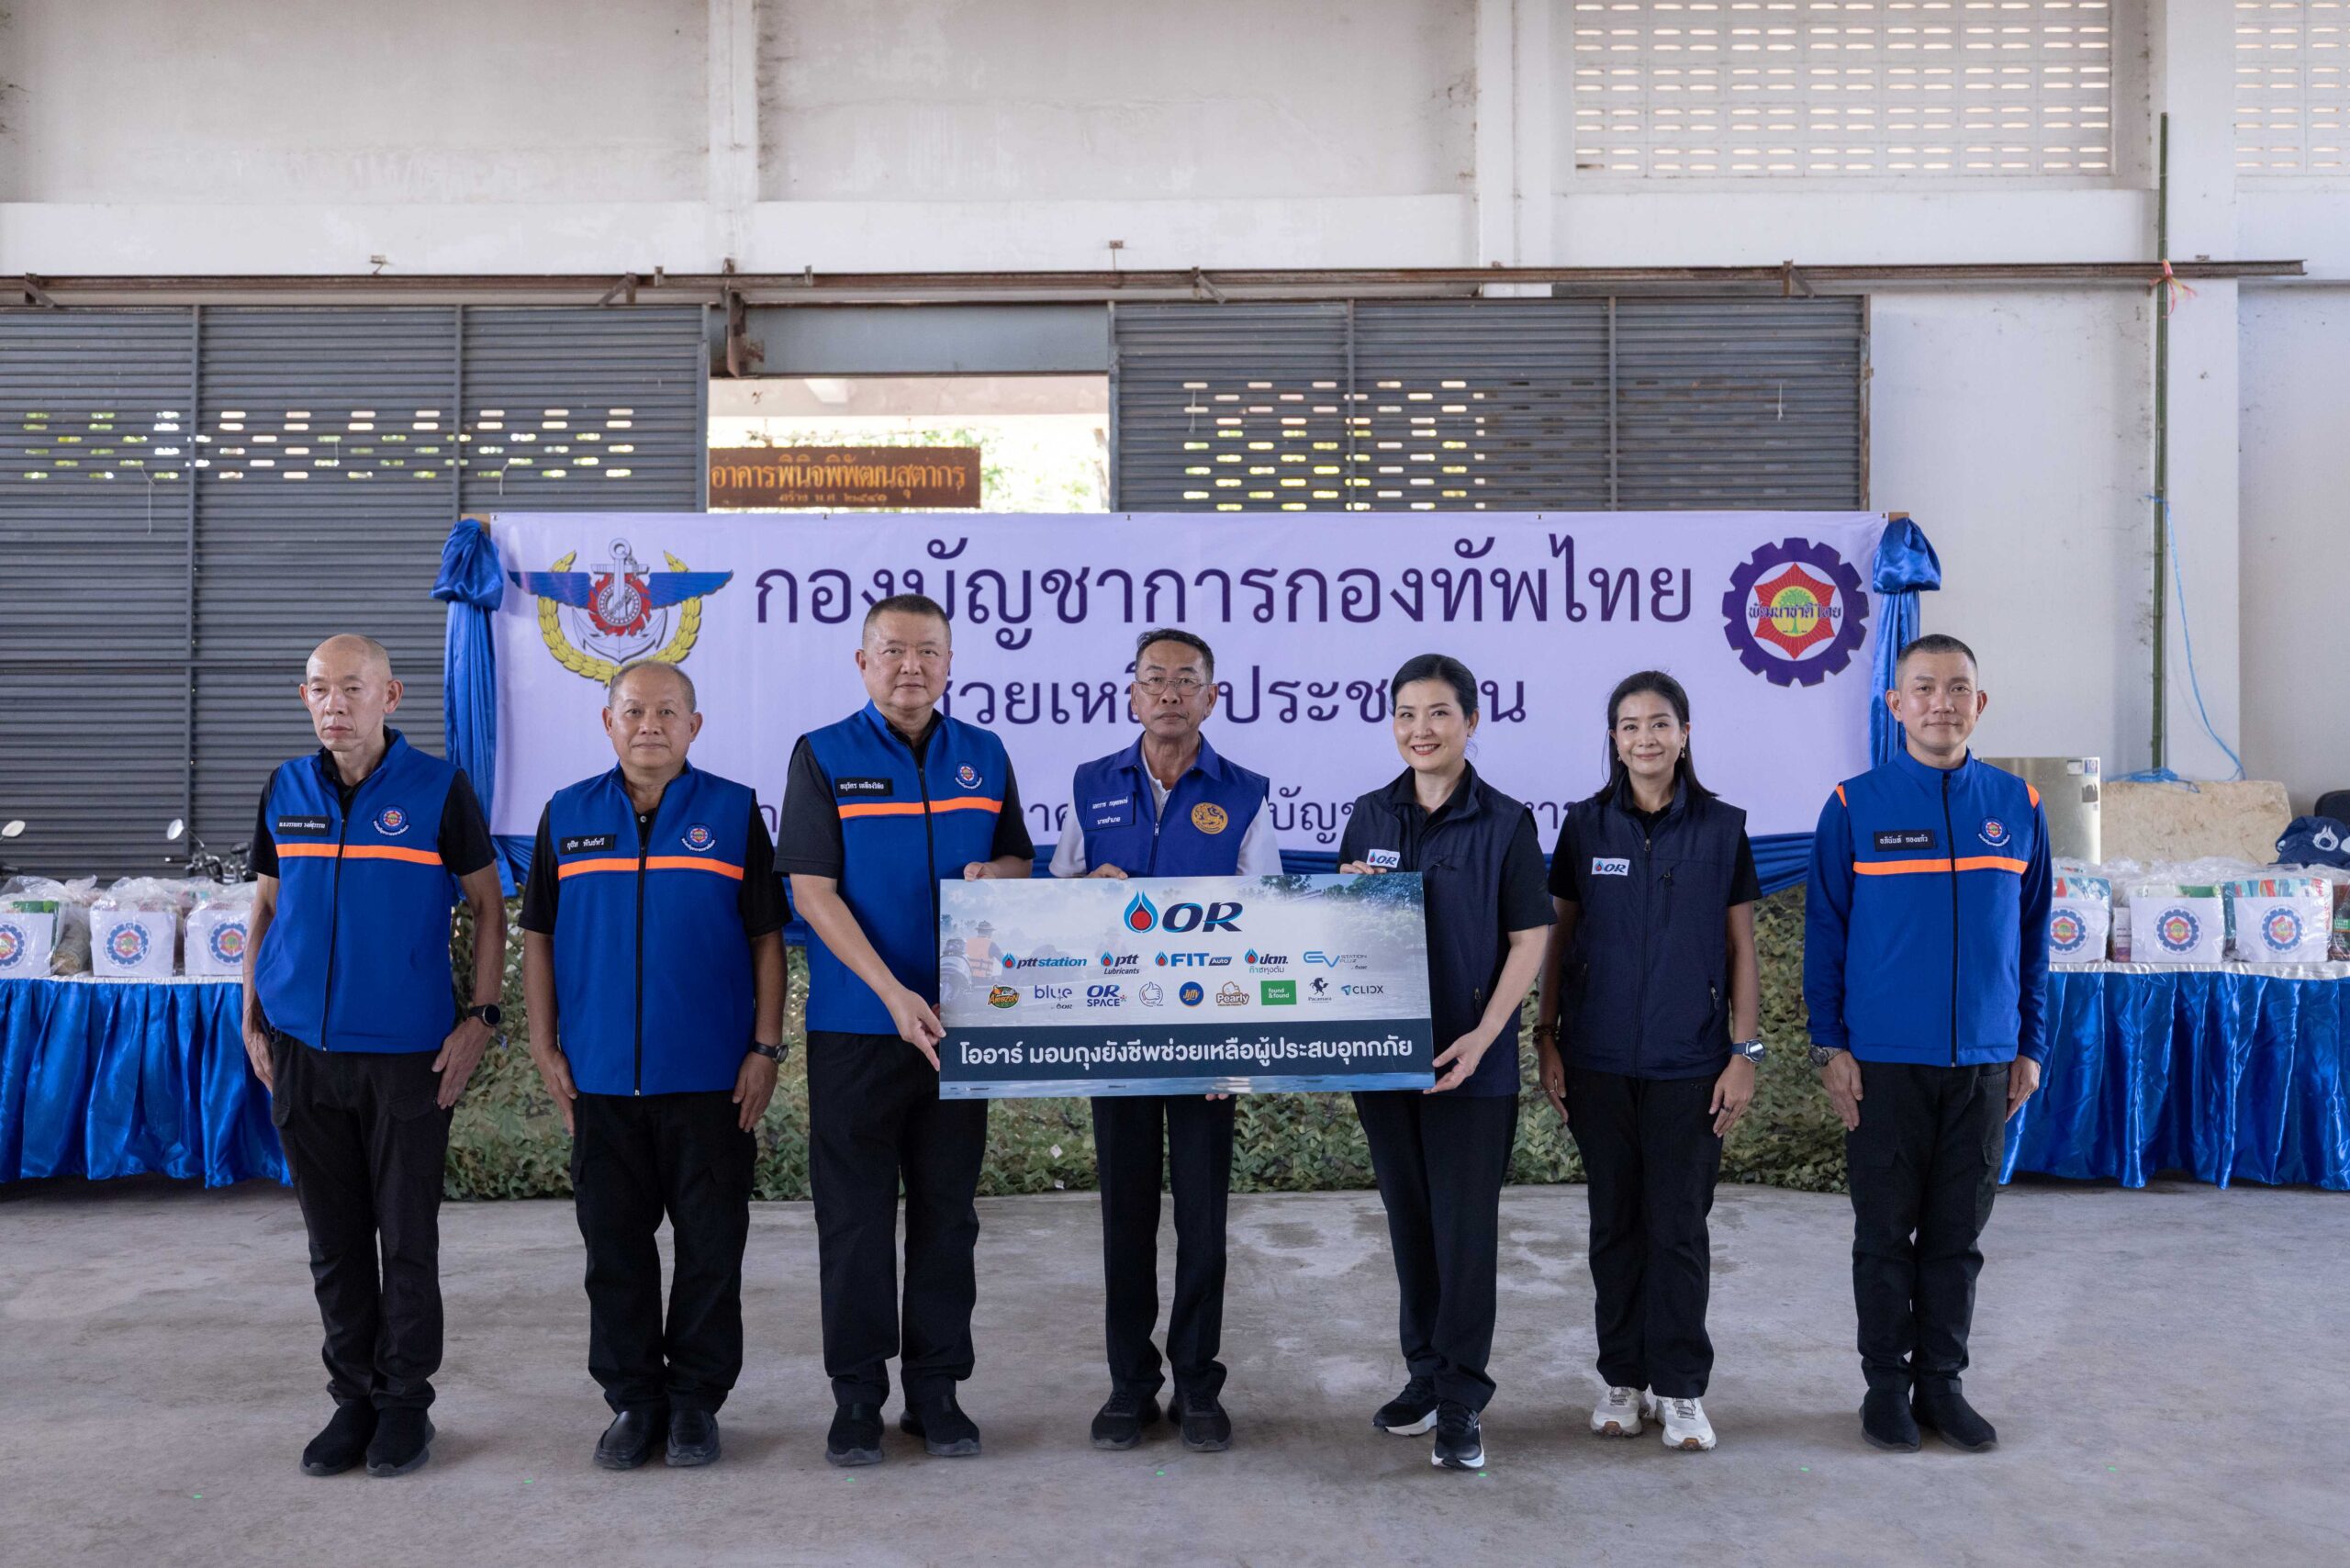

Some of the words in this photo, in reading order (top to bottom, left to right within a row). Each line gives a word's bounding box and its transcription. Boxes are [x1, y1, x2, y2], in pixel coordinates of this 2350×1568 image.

[755, 533, 1693, 650] กองบัญชาการกองทัพไทย
[1376, 855, 1398, 866] OR
[1603, 863, 1628, 873] OR
[1162, 902, 1244, 933] OR
[1114, 954, 1139, 968] ptt
[1170, 953, 1210, 967] FIT
[1103, 967, 1140, 976] Lubricants
[1087, 984, 1121, 998] OR
[1216, 993, 1249, 1005] Pearly
[959, 1040, 1024, 1064] โออาร์
[1029, 1035, 1413, 1070] มอบถุงยังชีพช่วยเหลือผู้ประสบอุทกภัย
